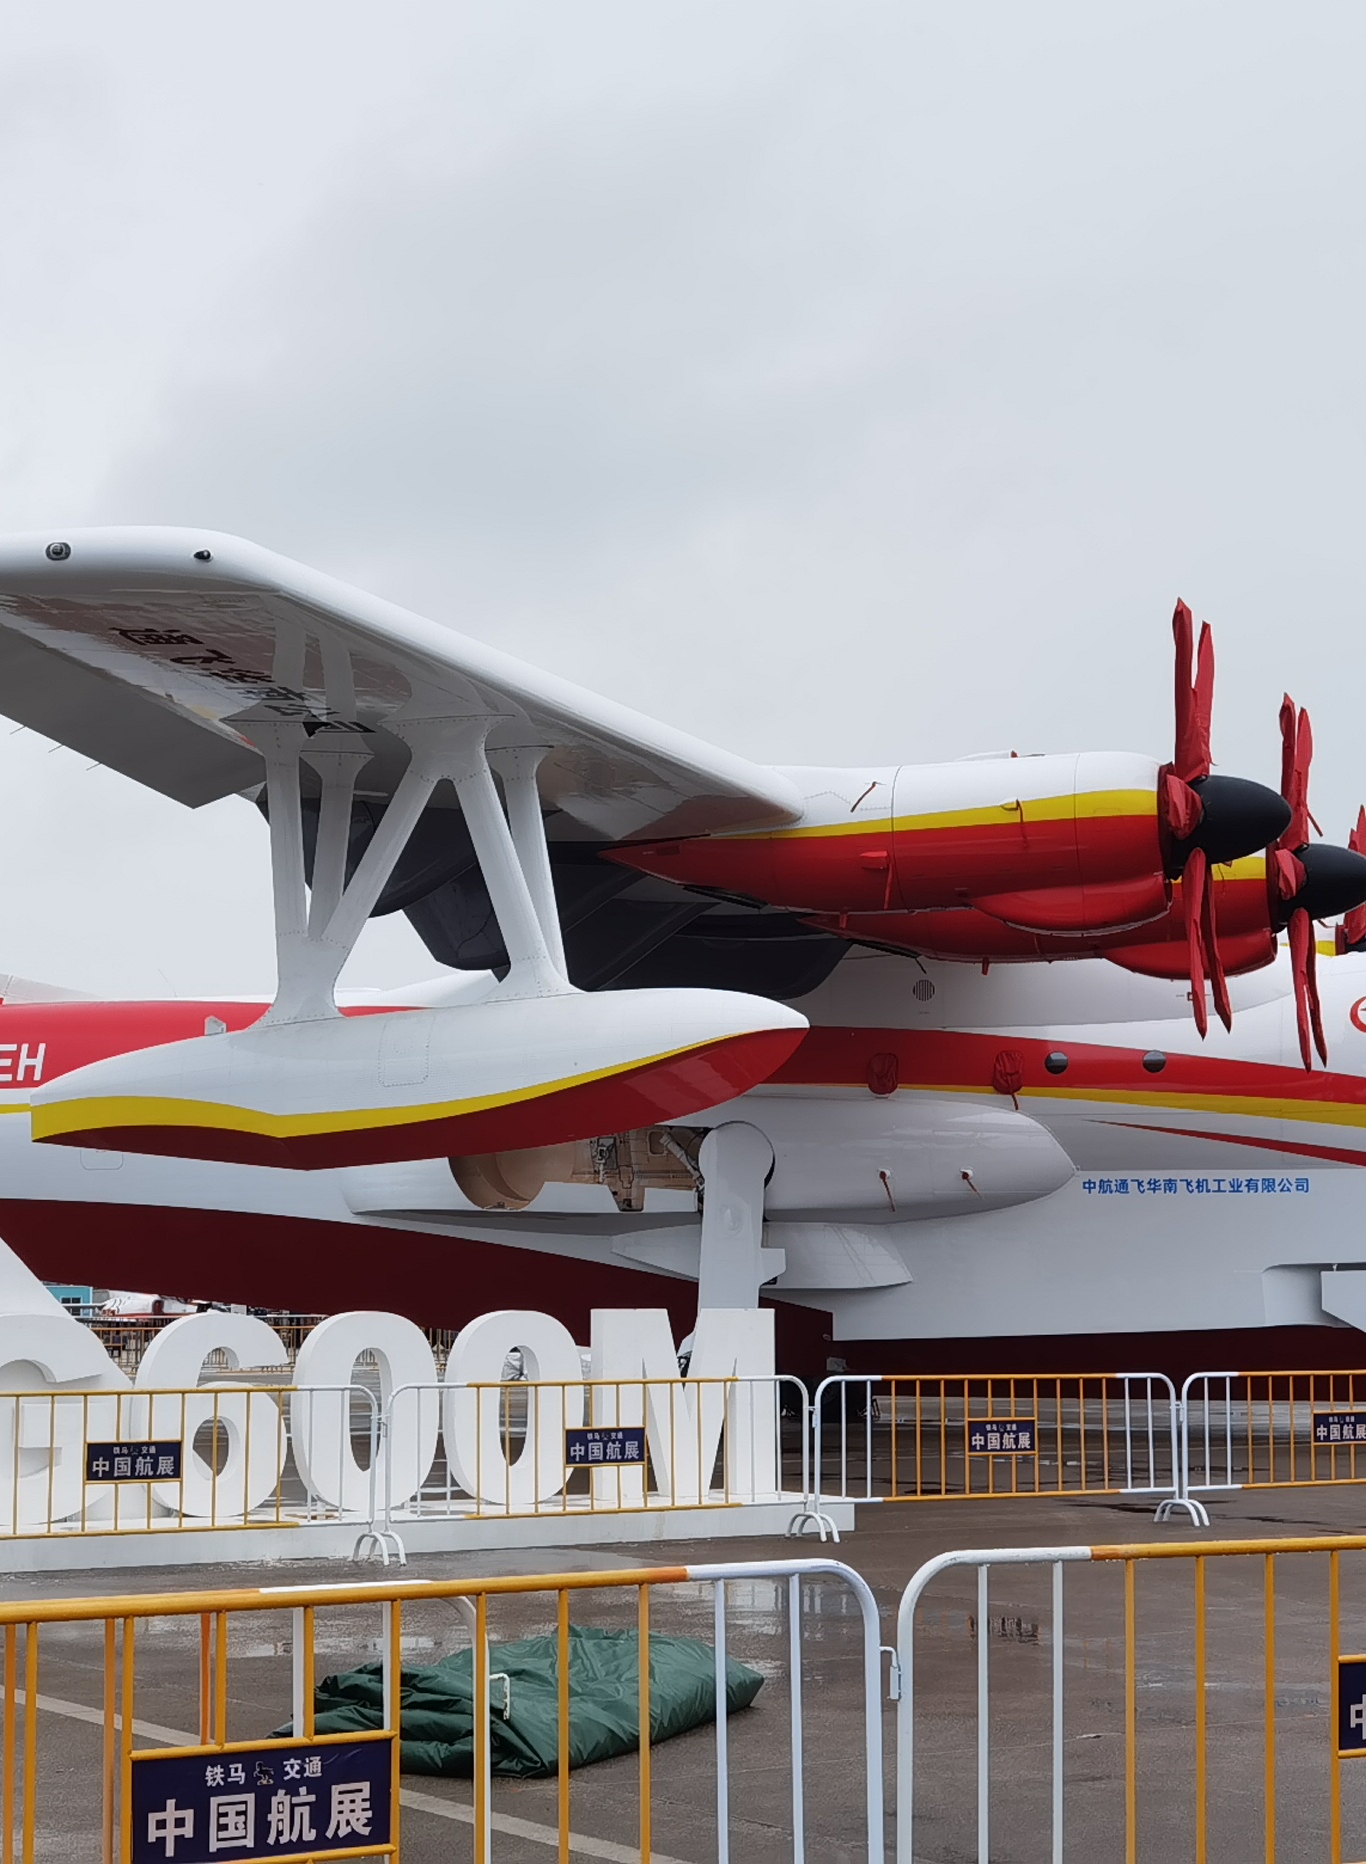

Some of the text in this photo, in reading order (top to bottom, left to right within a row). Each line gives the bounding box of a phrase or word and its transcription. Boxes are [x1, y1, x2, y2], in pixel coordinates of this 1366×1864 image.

[1082, 1177, 1310, 1195] 中航通飞华南飞机工业有限公司
[570, 1440, 640, 1462] 中国航展
[971, 1432, 1031, 1450] 中国航展
[92, 1456, 175, 1477] 中国航展
[204, 1756, 323, 1787] 铁马 交通
[147, 1781, 373, 1858] 中国航展
